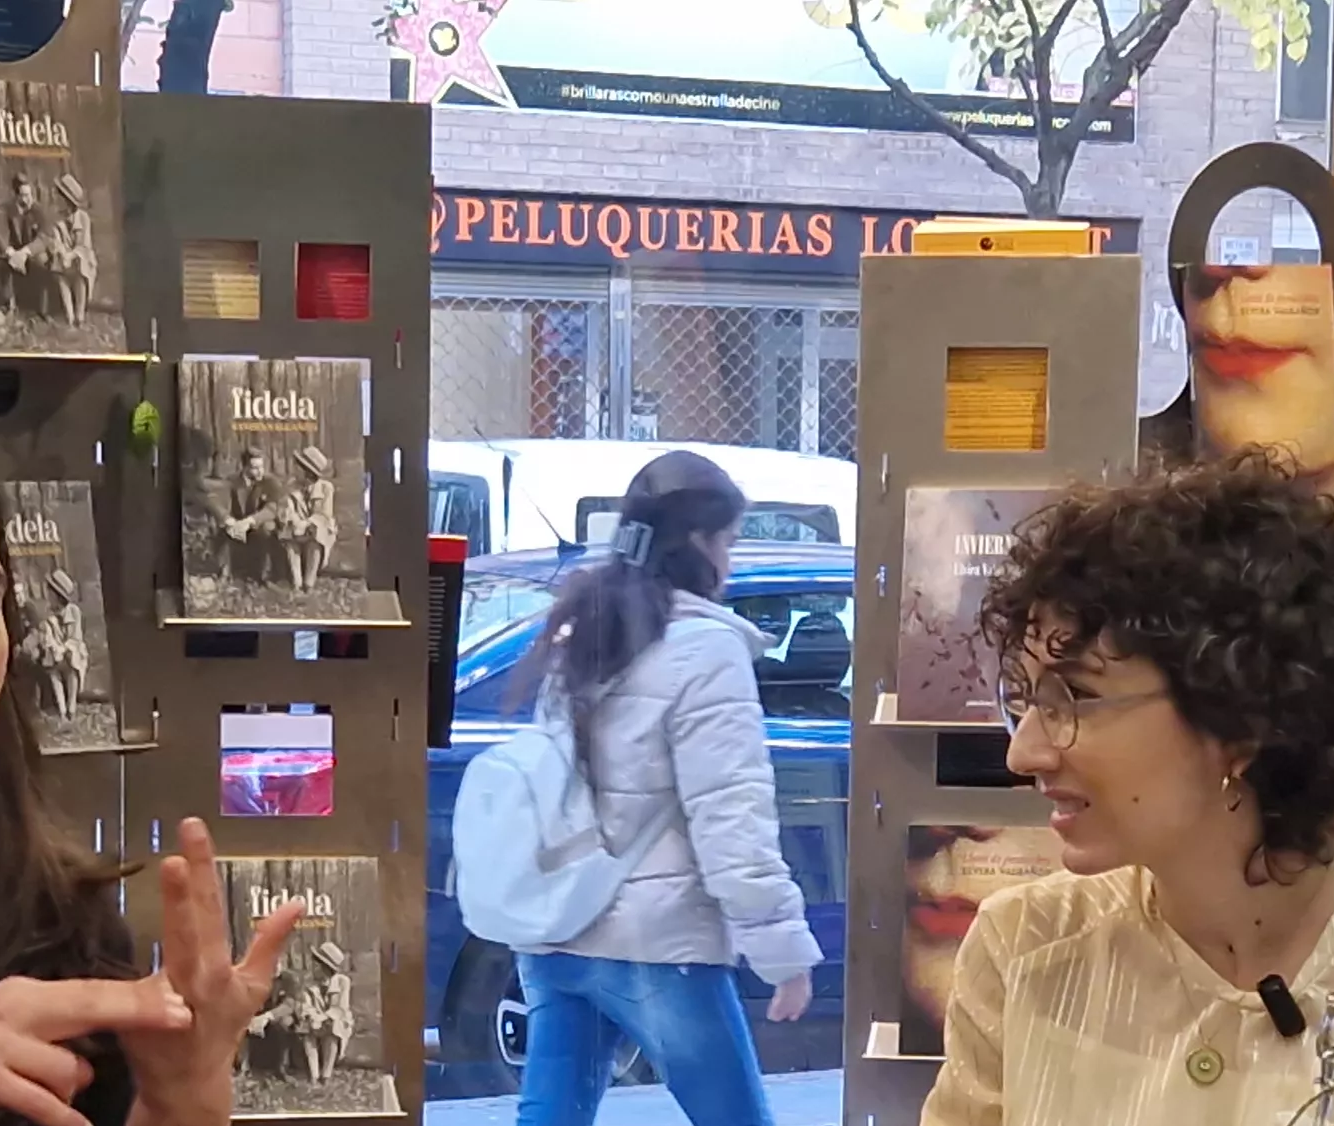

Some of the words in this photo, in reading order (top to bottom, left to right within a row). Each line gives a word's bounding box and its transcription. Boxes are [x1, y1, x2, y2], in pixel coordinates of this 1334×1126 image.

[453, 196, 835, 258] PELUQUERIAS
[231, 386, 318, 421] fidela
[4, 511, 62, 544] dela
